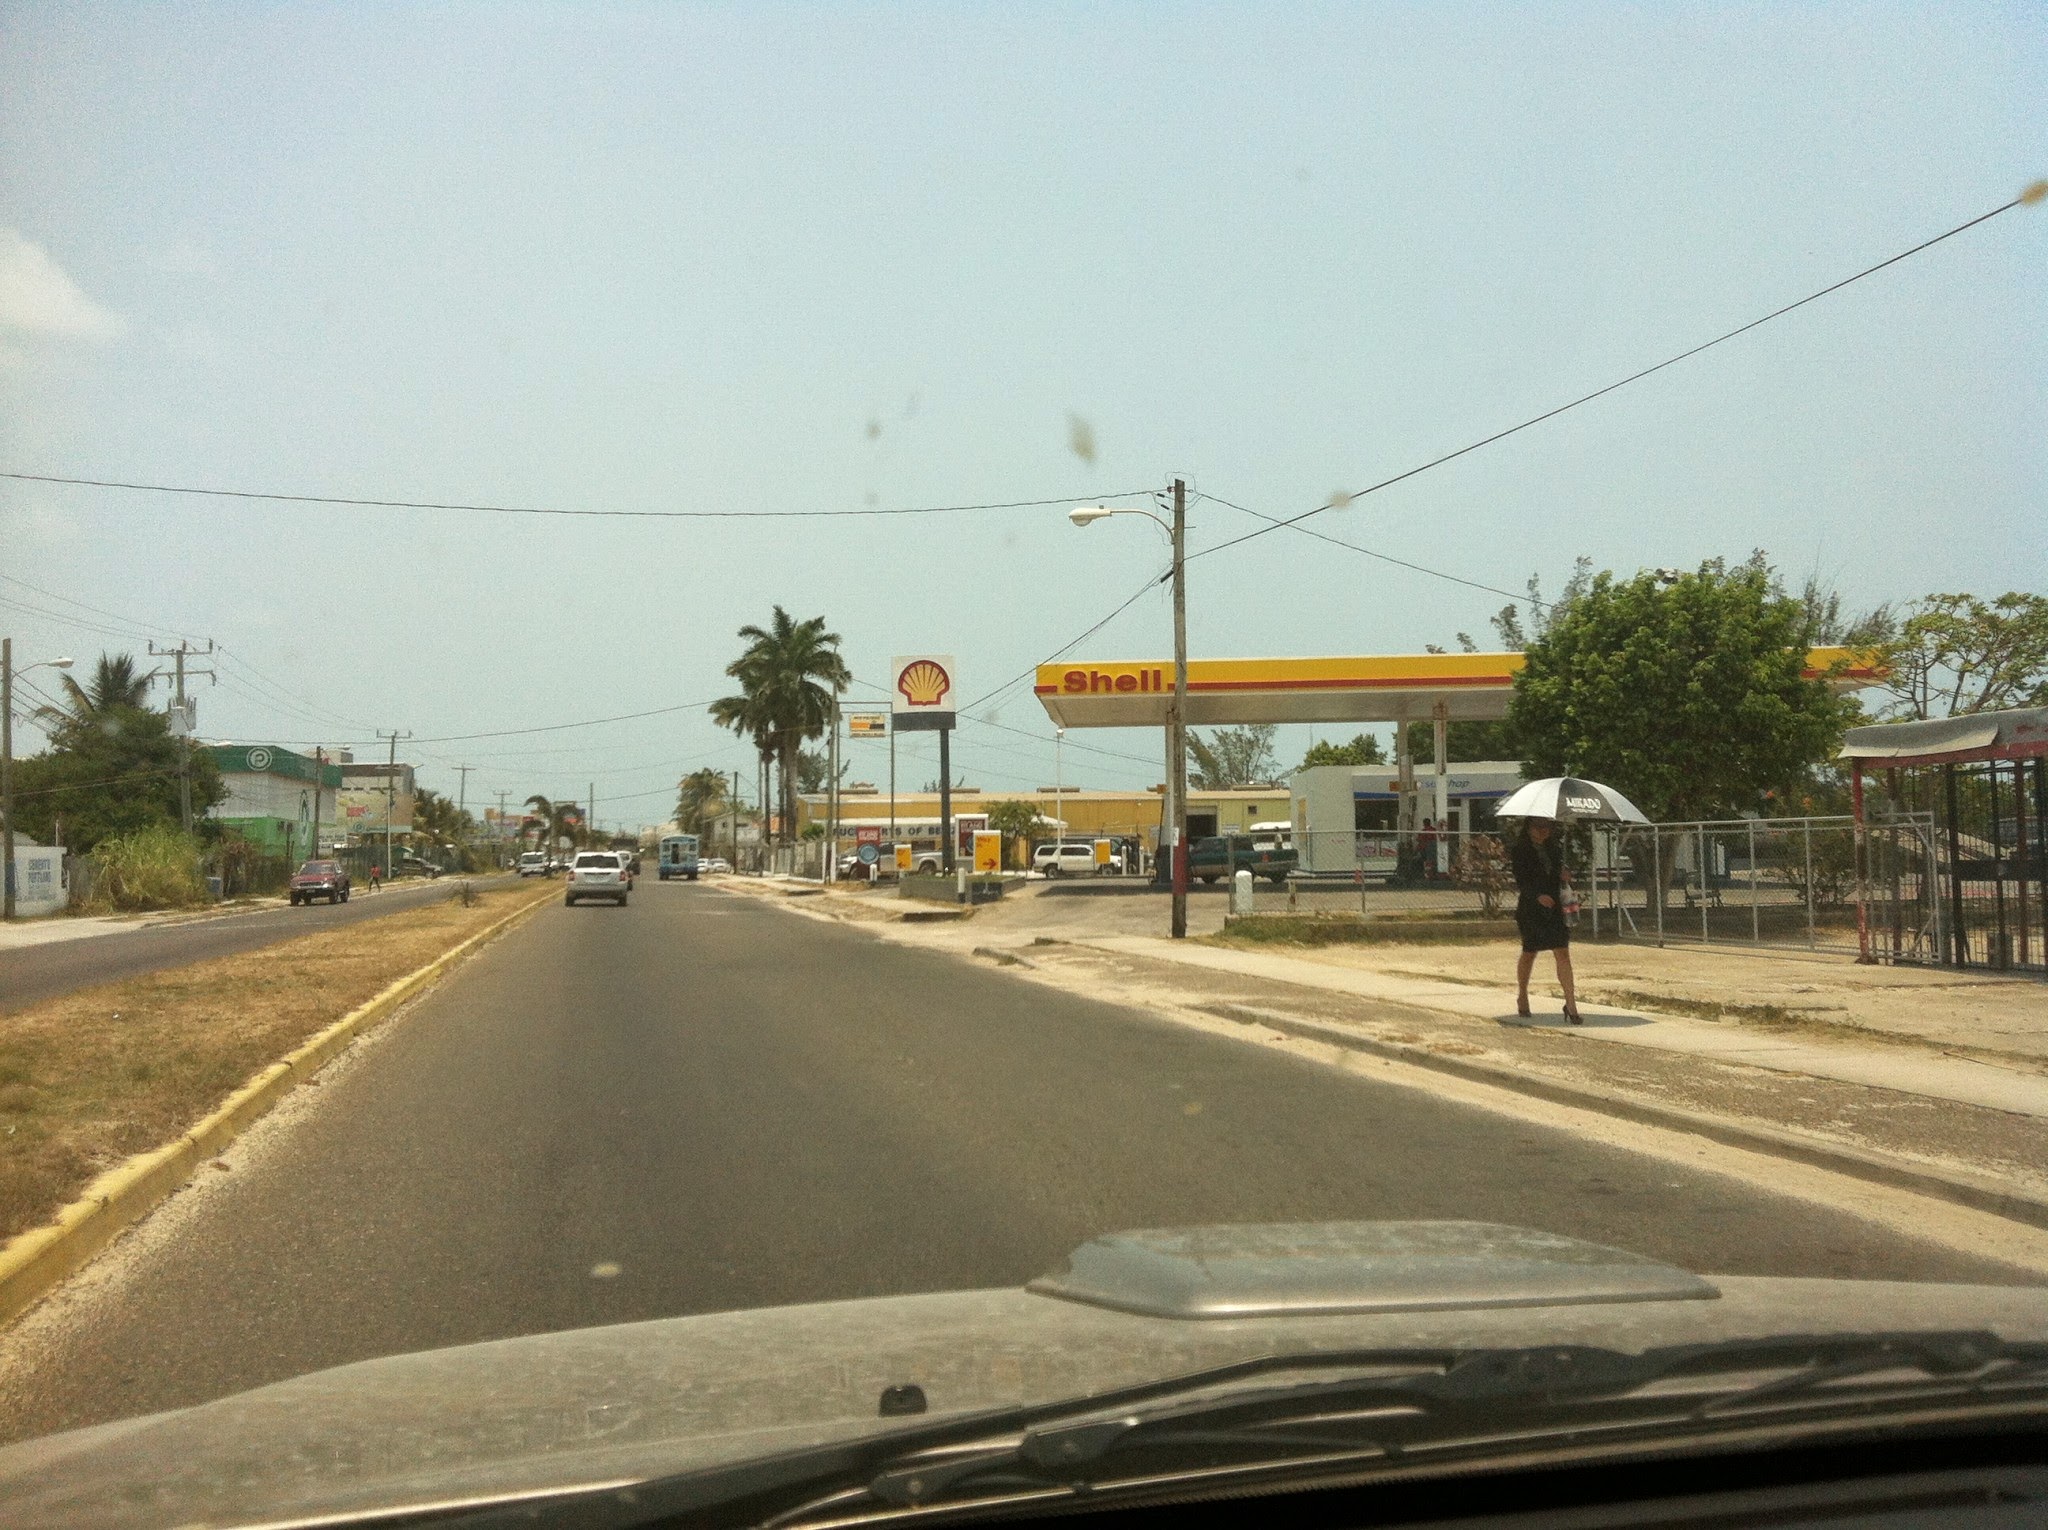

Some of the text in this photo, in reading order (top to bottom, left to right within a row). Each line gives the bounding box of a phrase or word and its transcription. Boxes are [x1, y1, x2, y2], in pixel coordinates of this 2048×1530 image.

[1064, 670, 1161, 692] Shell
[1566, 797, 1601, 809] MIKADO
[908, 827, 922, 835] OF
